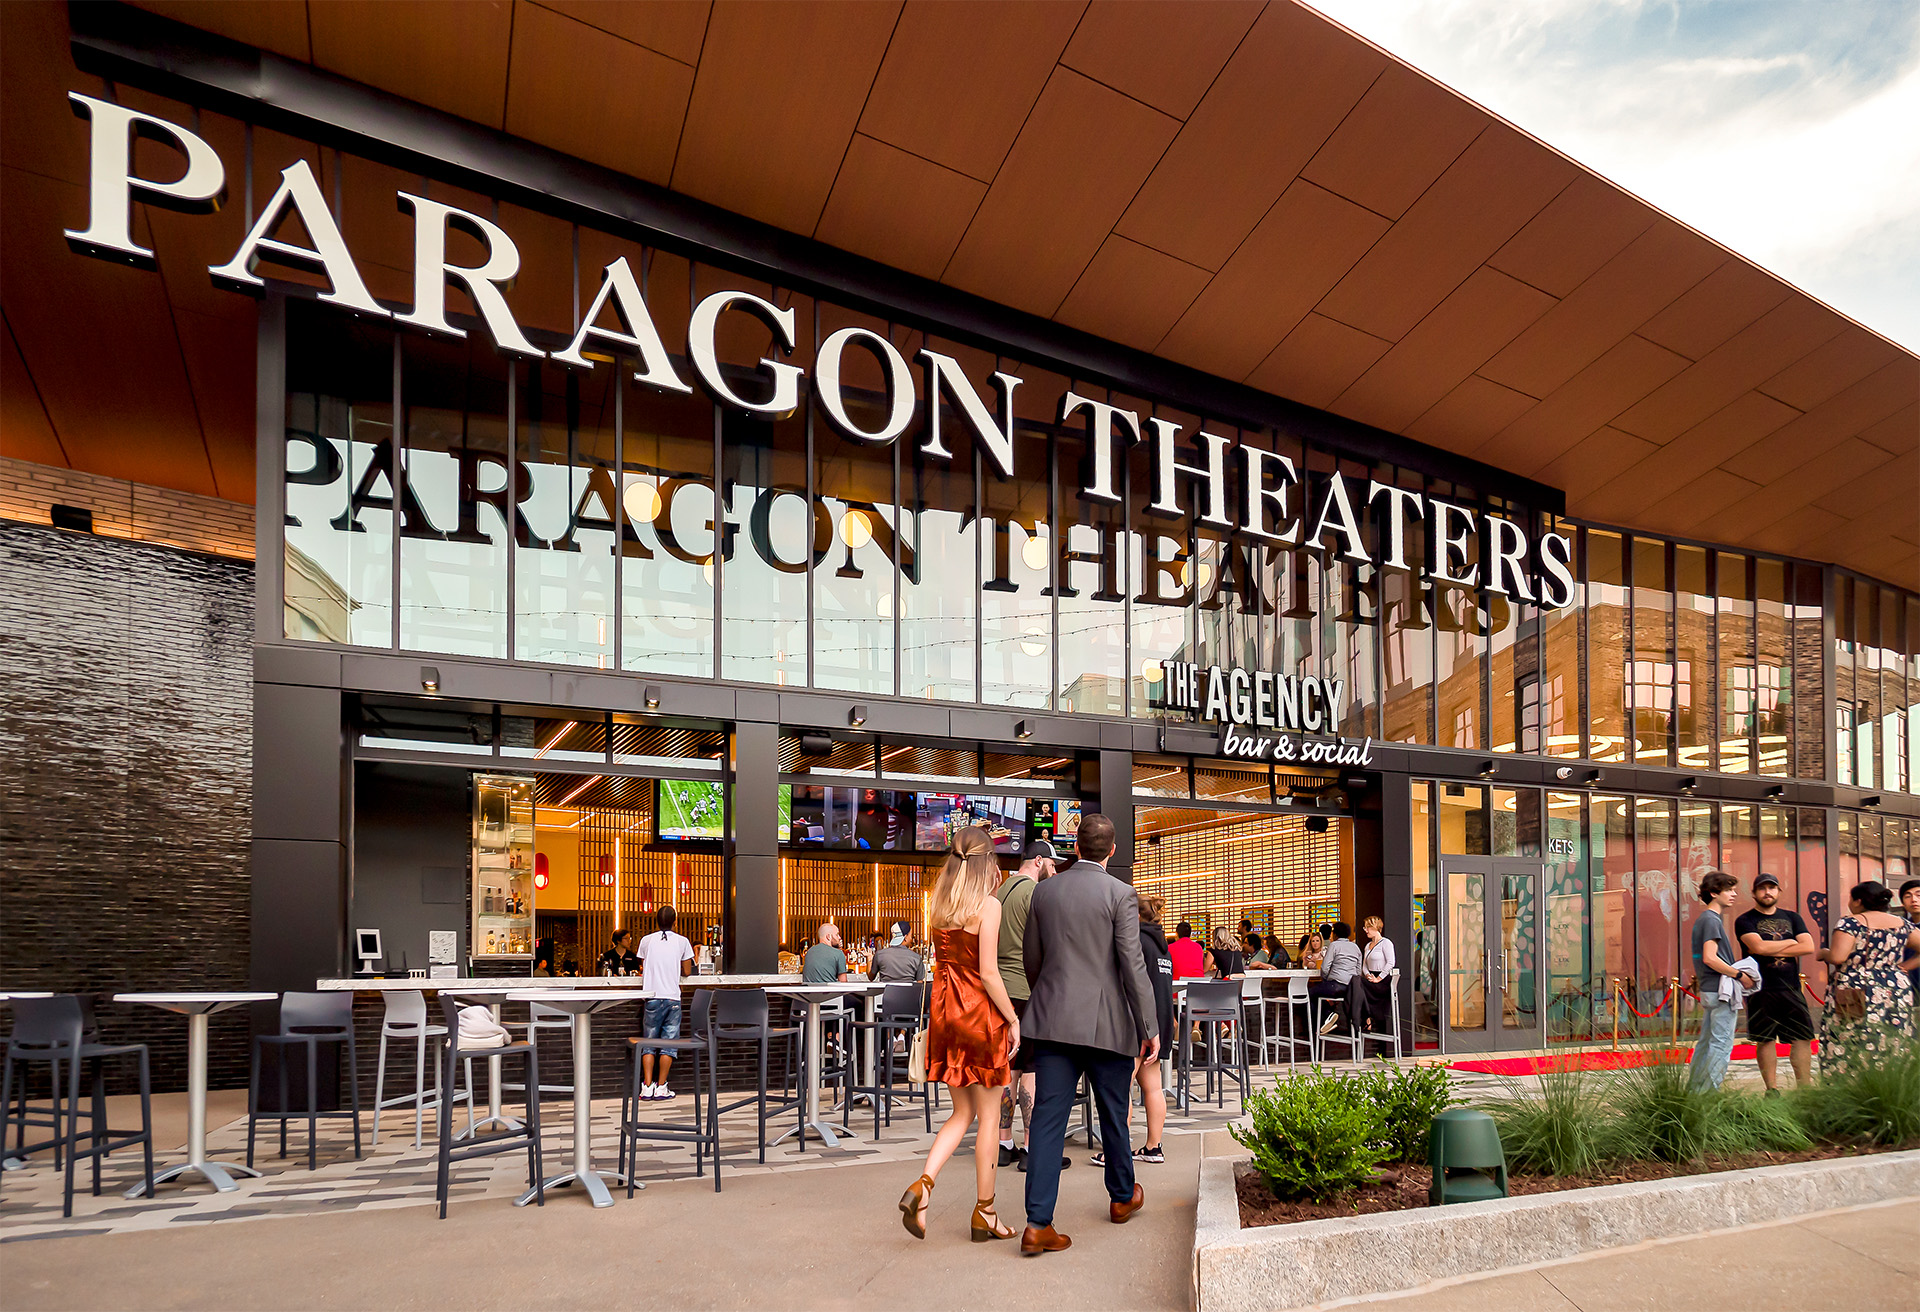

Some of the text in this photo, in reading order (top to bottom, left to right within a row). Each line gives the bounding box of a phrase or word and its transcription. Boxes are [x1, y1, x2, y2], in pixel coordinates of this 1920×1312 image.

[64, 90, 1576, 609] PARAGON THEATERS
[1163, 661, 1344, 732] THE AGENCY
[1223, 723, 1373, 766] bar & social
